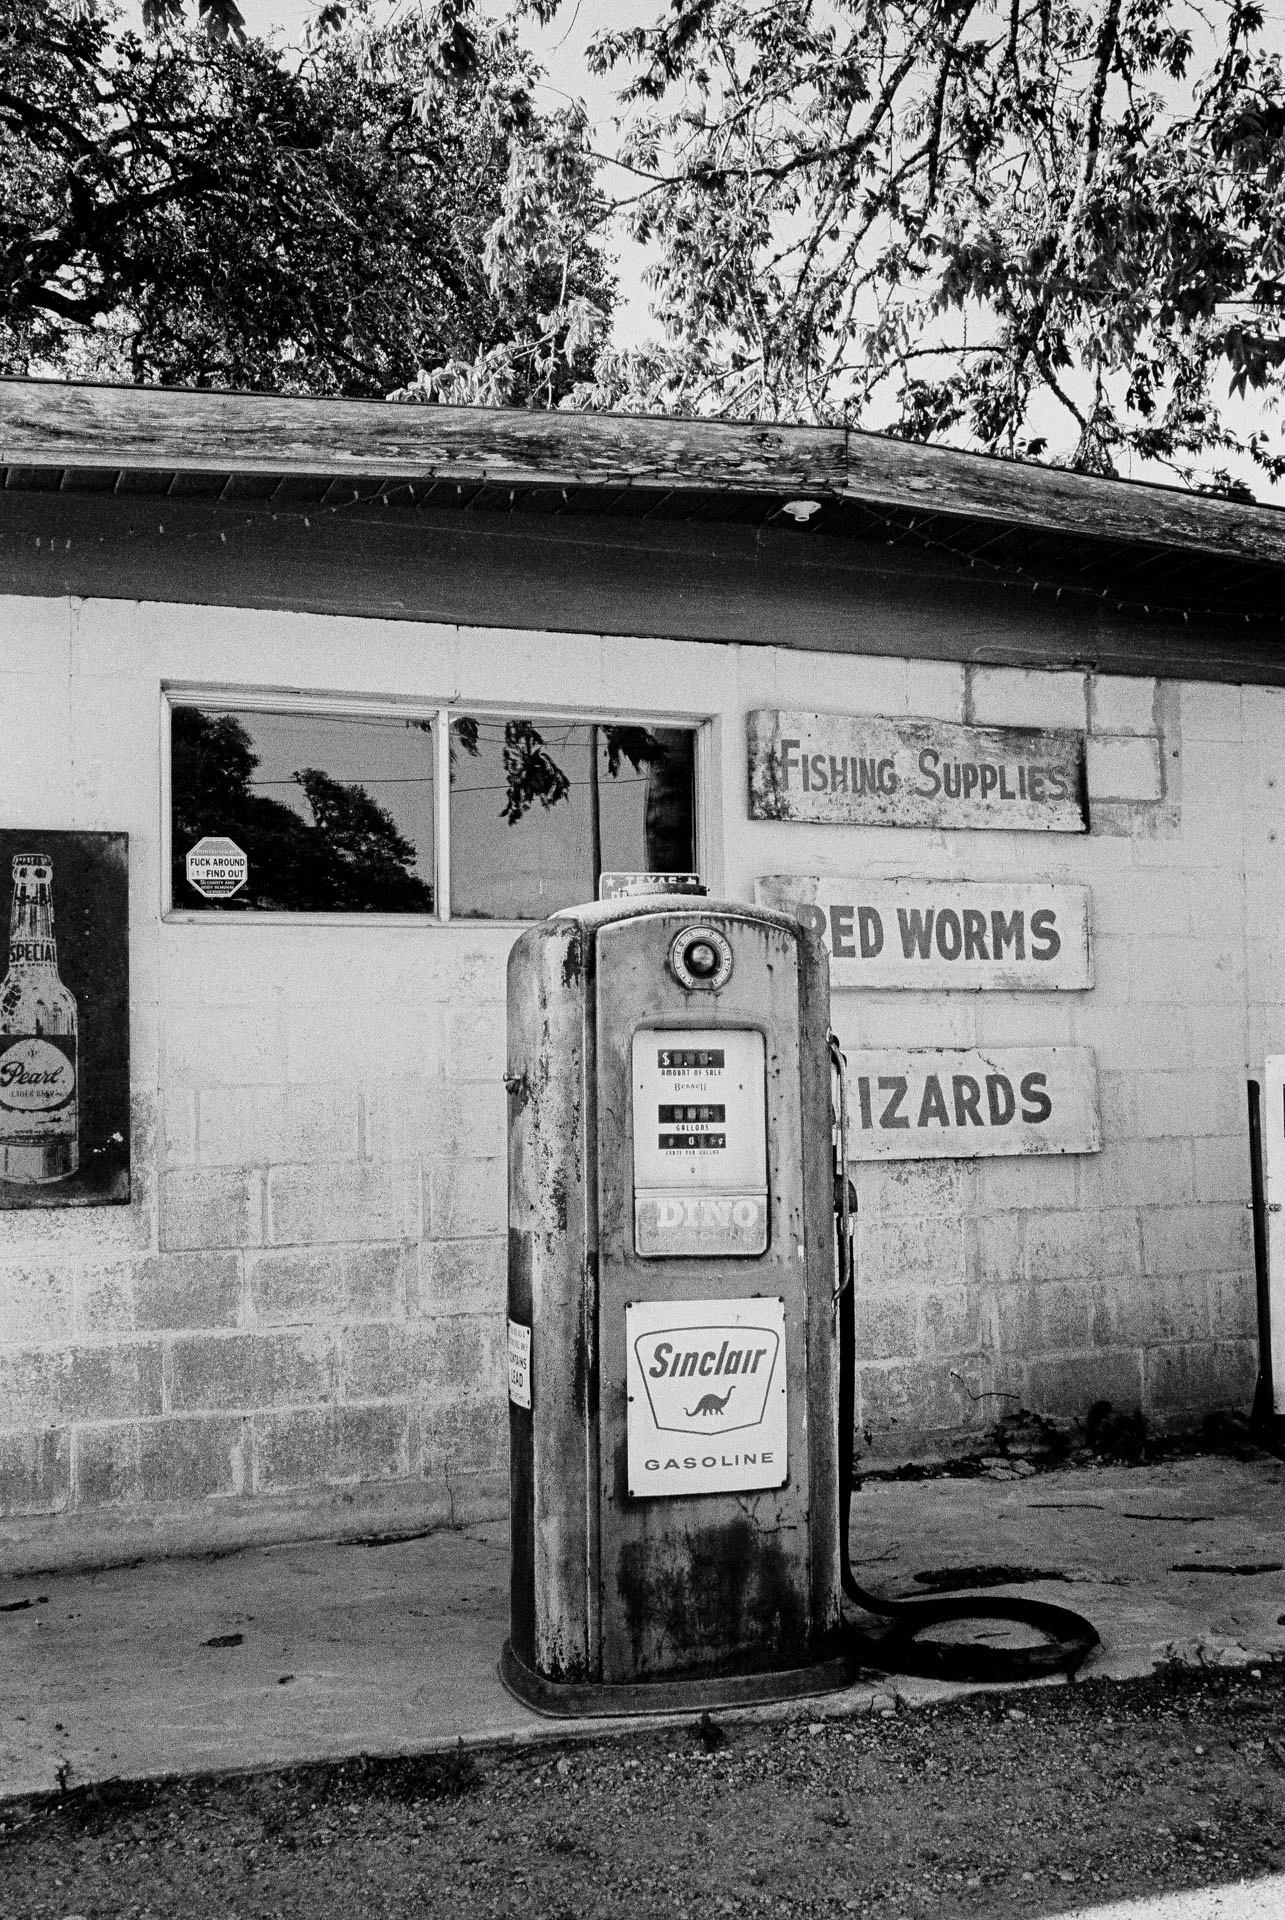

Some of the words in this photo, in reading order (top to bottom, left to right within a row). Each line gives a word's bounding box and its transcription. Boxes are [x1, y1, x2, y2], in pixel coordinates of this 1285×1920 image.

[779, 739, 899, 796] FISHING
[914, 748, 1069, 801] SUPPLIES
[190, 858, 211, 867] FUCK
[213, 858, 245, 867] AROUND
[206, 869, 226, 878] FIND
[227, 869, 244, 878] OUT
[797, 904, 884, 958] RED
[896, 908, 1061, 961] WORMS
[0, 1061, 64, 1087] Pearl
[661, 1069, 690, 1077] AMOUNT
[694, 1069, 702, 1077] OF
[705, 1069, 722, 1077] SALE
[857, 1072, 1053, 1130] IZARDS
[675, 1124, 709, 1132] GALLONS
[656, 1200, 758, 1229] DINO
[649, 1341, 767, 1378] Sinclair
[644, 1452, 774, 1471] GASOLINE
